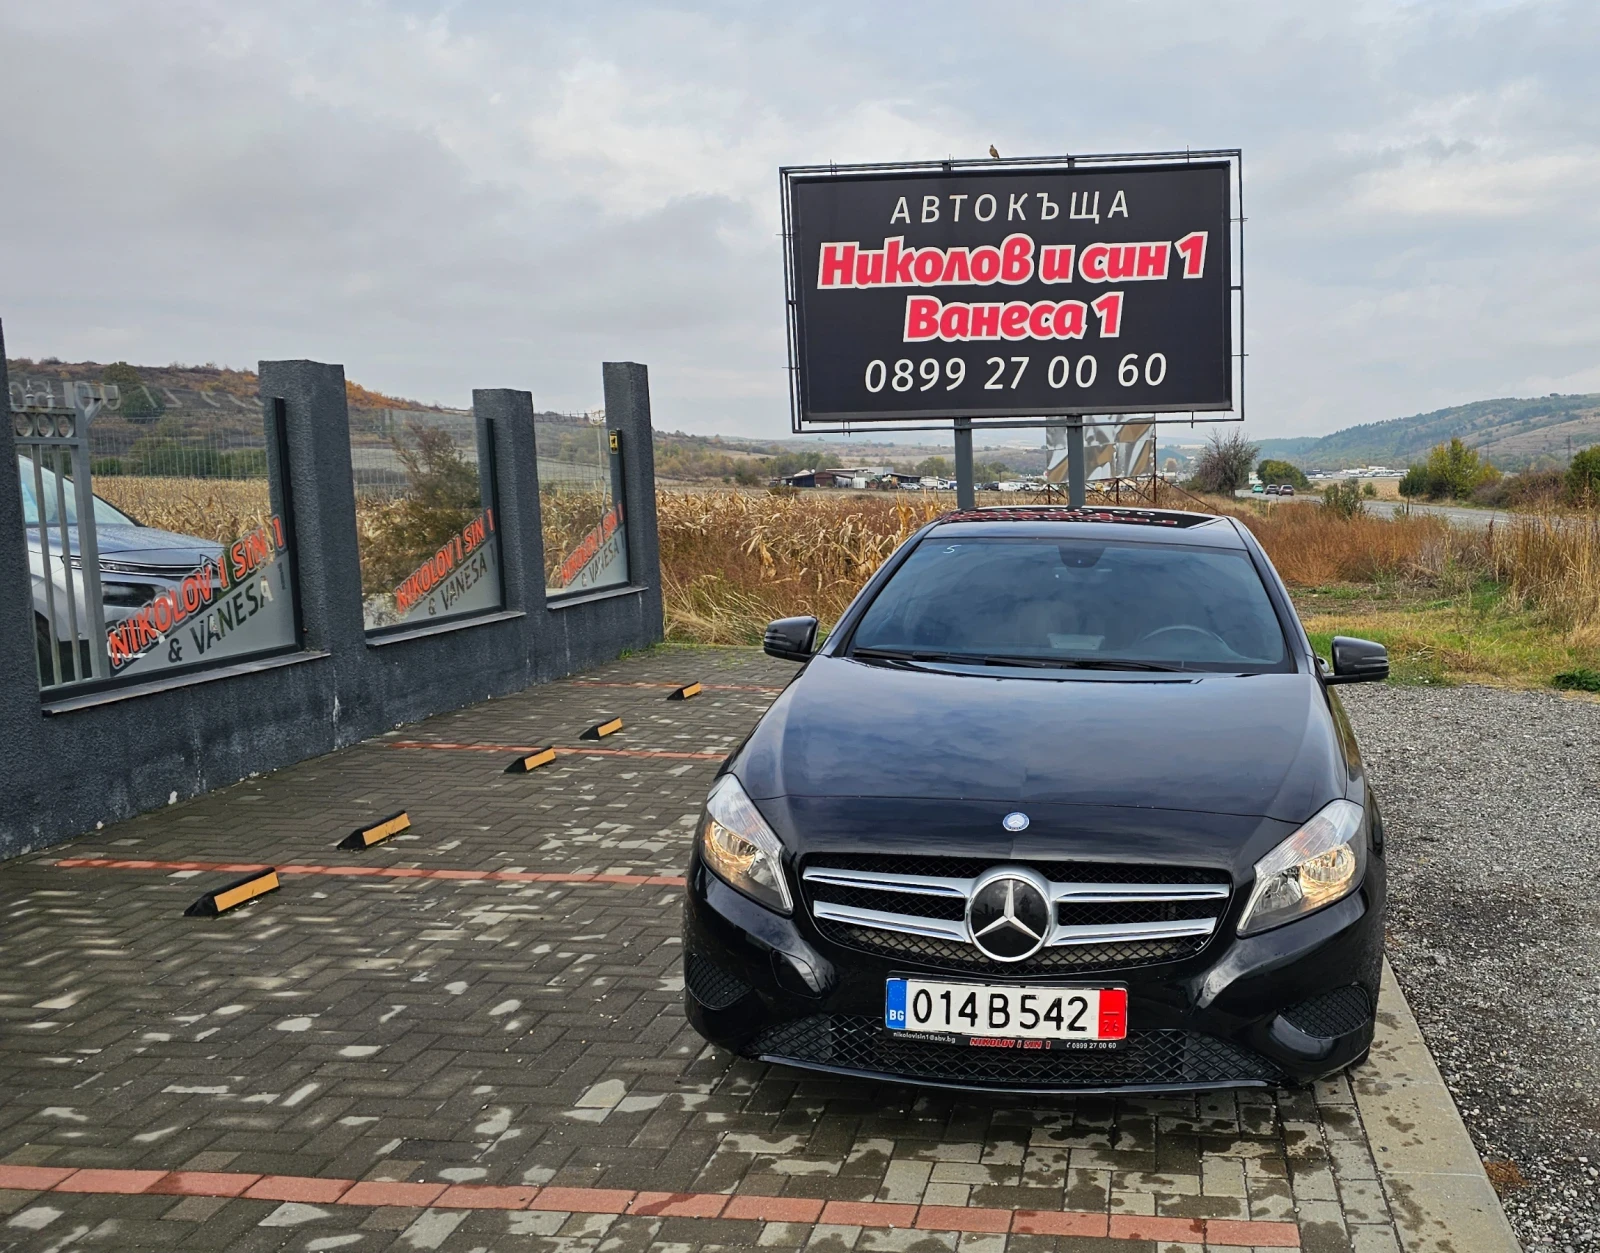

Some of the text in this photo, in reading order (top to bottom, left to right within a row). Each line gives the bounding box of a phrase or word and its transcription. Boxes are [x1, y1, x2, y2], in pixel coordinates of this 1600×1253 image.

[890, 189, 1130, 225] АВТОКЪЩА
[817, 231, 1208, 290] Николов и син 1
[902, 291, 1124, 342] Ванеса 1
[864, 352, 1168, 393] 0899 27 00 60
[395, 540, 454, 614] NIKOLOV
[463, 514, 486, 555] SIN
[428, 597, 437, 616] &
[441, 551, 488, 611] VANESA
[107, 562, 213, 668] NIKOLOV
[231, 527, 268, 580] SIN
[167, 636, 183, 664] &
[189, 575, 273, 656] VANESA
[888, 1009, 905, 1021] BG
[969, 1037, 1015, 1049] NIKOLOV
[1023, 1040, 1043, 1050] SIN
